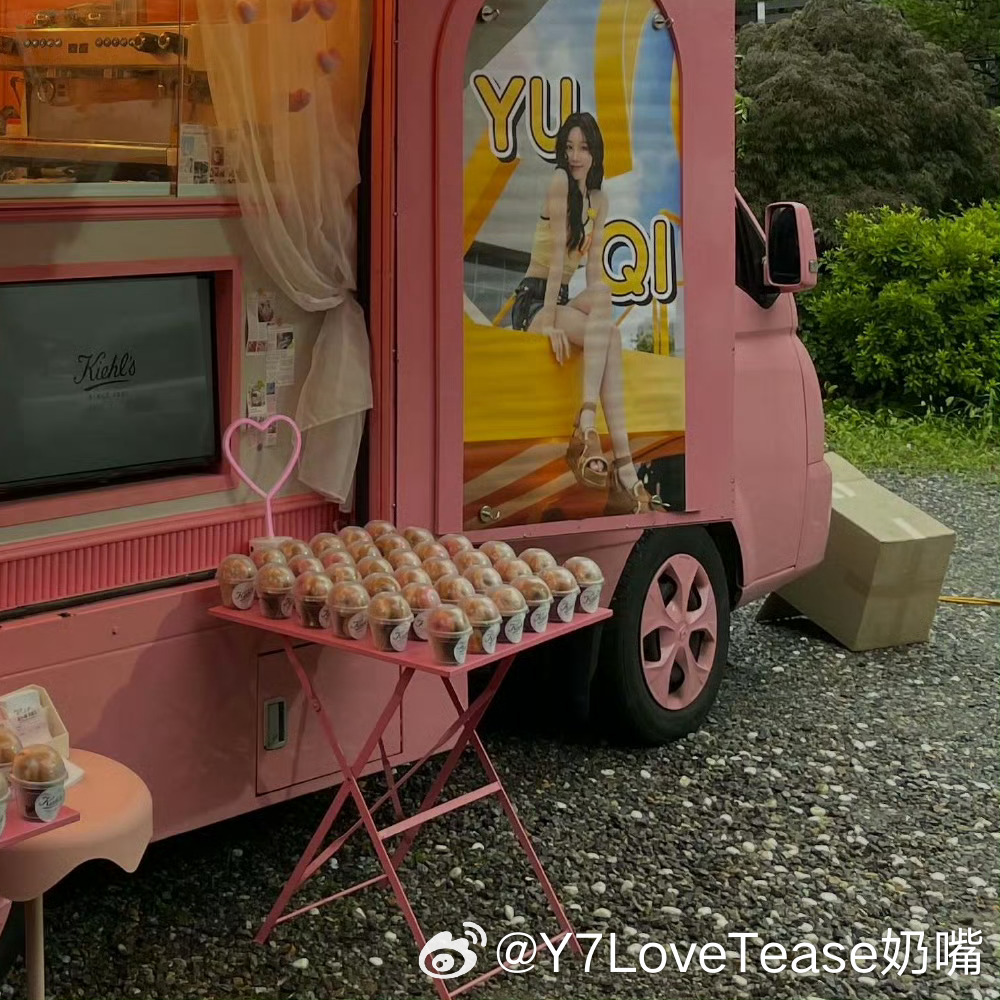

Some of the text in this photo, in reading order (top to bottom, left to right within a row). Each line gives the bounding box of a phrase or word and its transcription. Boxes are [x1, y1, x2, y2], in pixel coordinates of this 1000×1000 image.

[471, 73, 579, 163] YU
[601, 214, 680, 305] QI
[73, 351, 136, 385] Kiehl's
